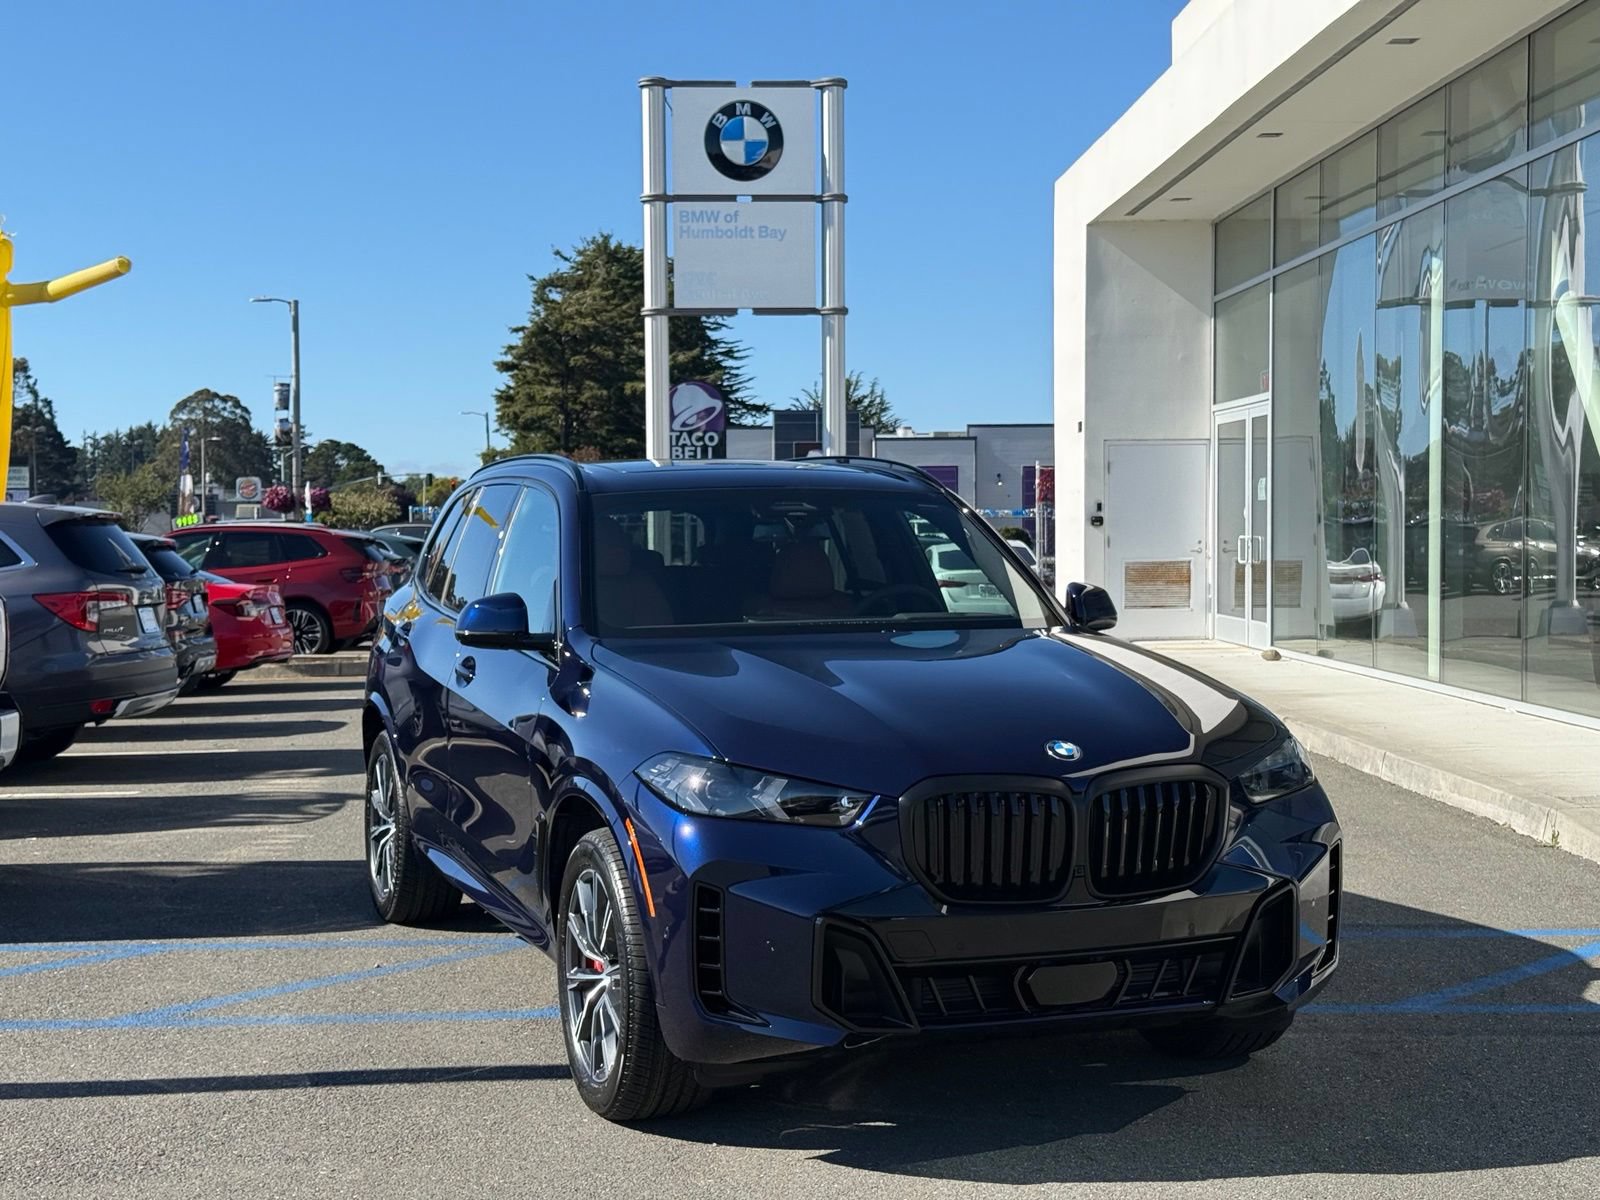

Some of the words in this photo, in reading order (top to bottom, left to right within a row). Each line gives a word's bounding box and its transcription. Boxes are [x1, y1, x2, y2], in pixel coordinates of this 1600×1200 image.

[712, 102, 777, 129] BMW
[679, 210, 720, 223] BMW
[723, 210, 740, 223] of
[678, 226, 755, 240] Humboldt
[758, 226, 788, 242] Bay
[669, 432, 719, 446] TACO
